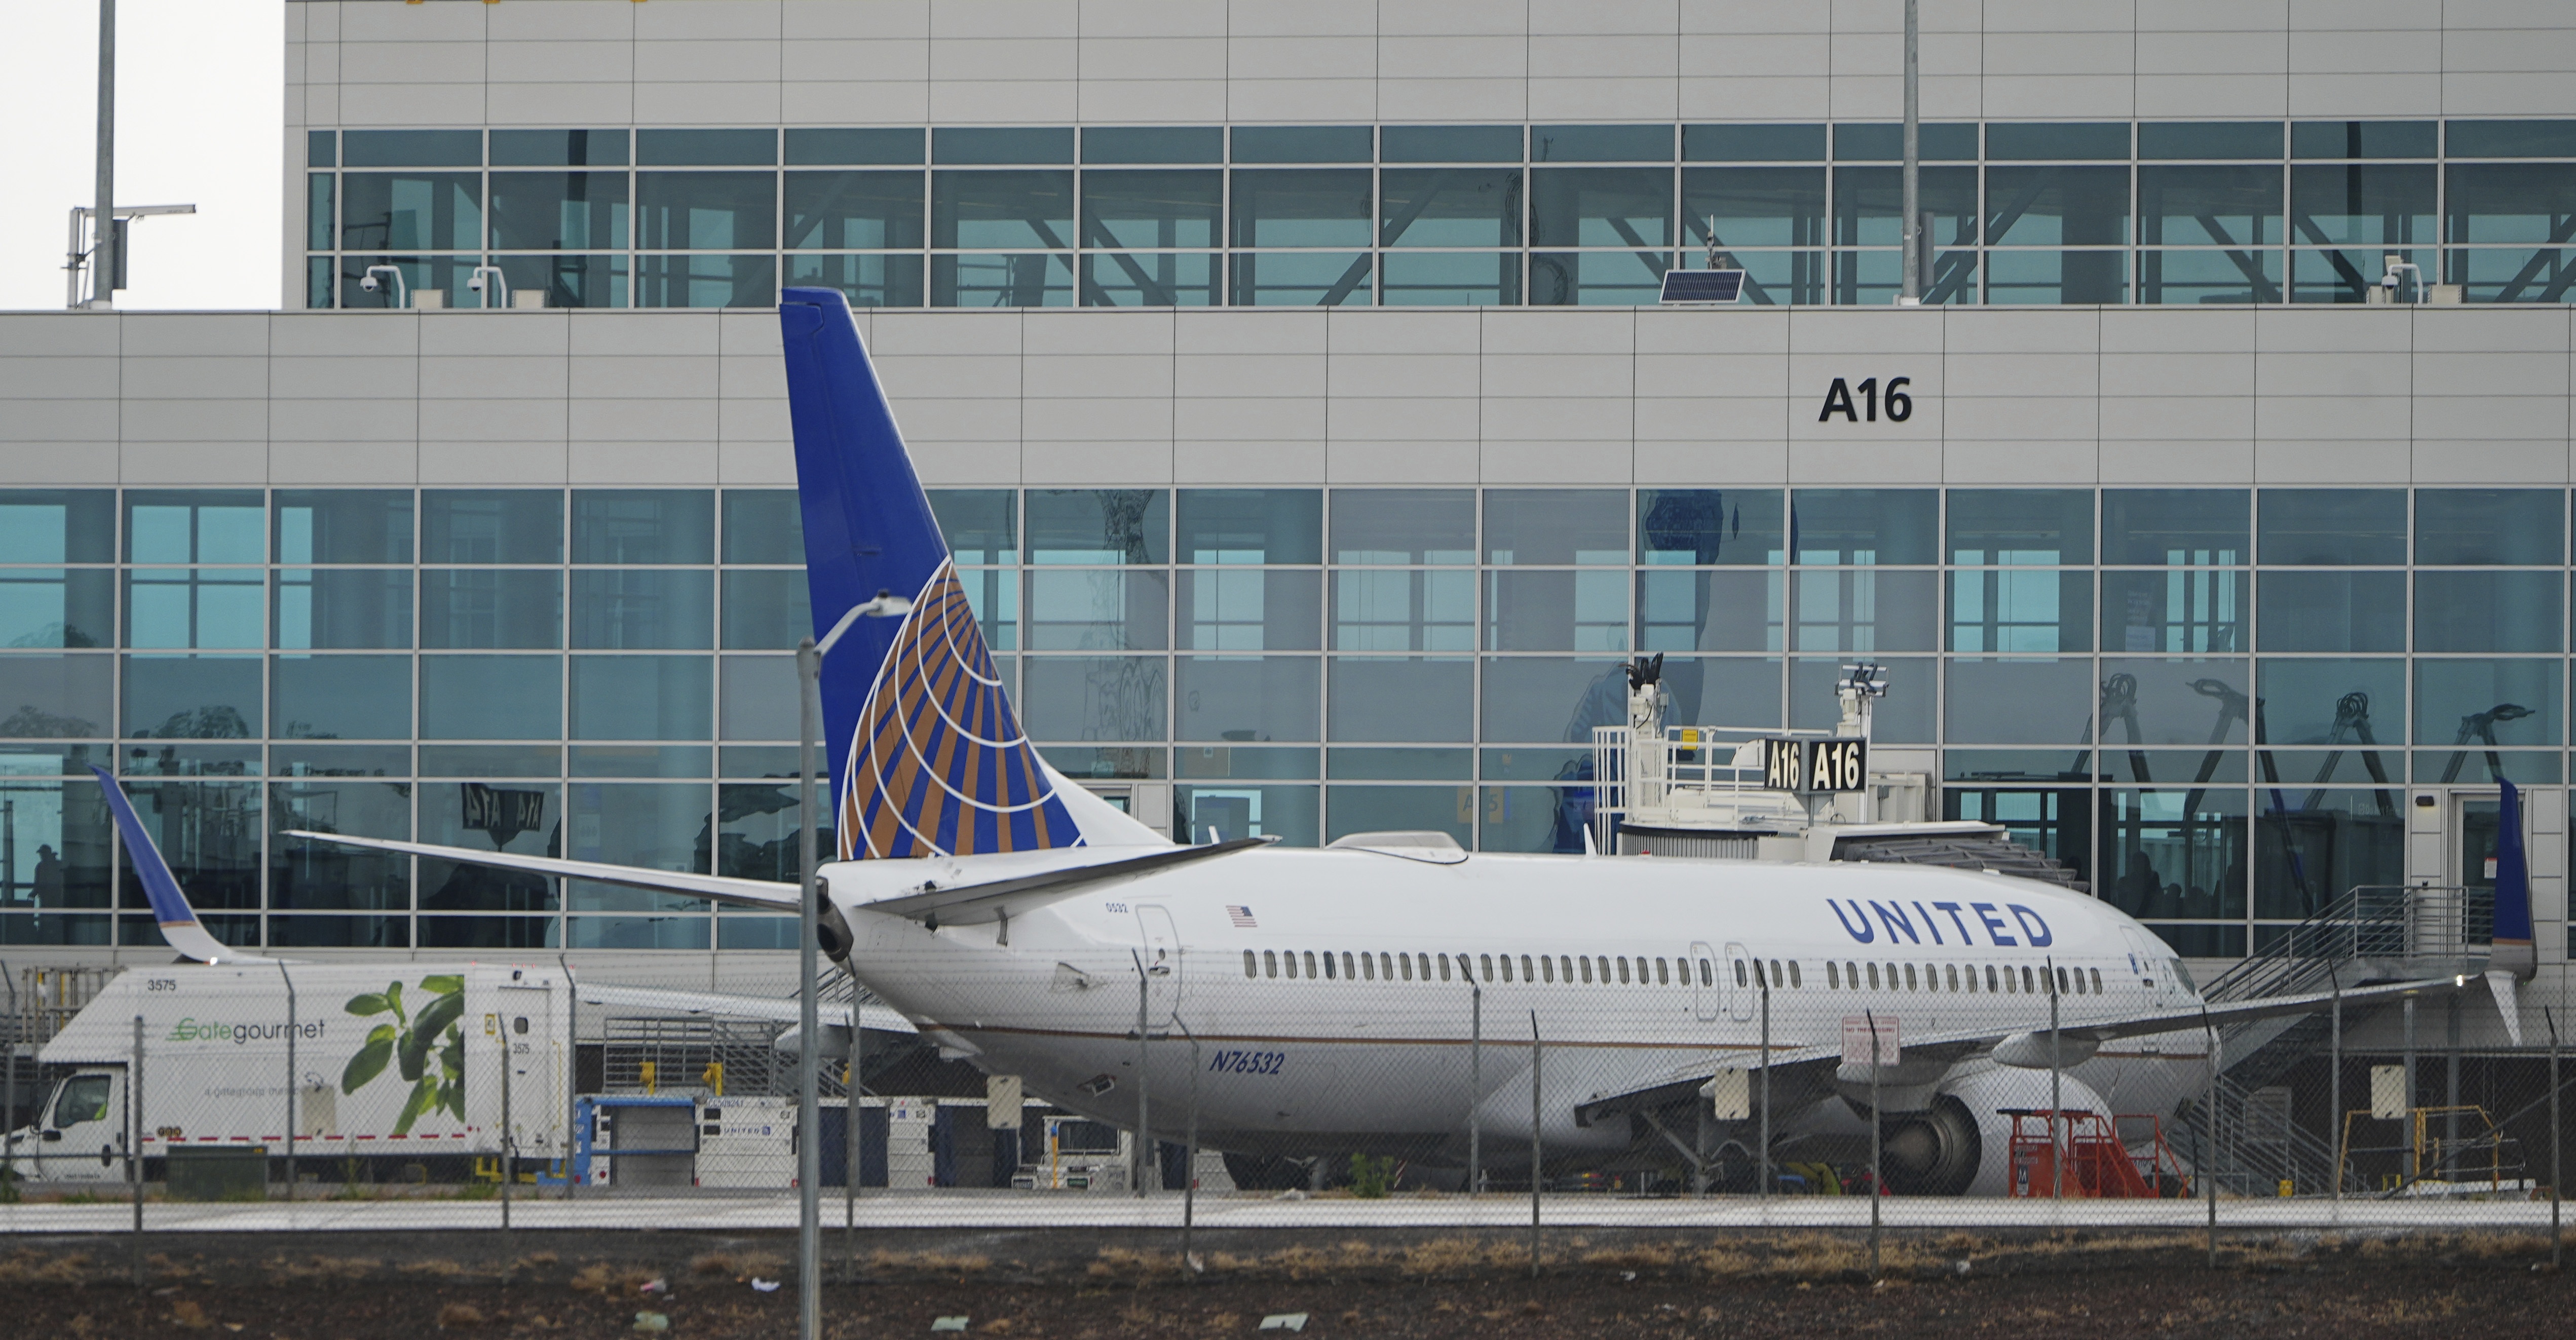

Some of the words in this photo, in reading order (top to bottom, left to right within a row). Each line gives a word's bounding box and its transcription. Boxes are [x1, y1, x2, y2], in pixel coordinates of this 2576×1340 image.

[1819, 376, 1912, 422] A16
[1768, 740, 1799, 790] A16
[1812, 742, 1860, 790] A16
[1826, 899, 2053, 947] UNITED
[147, 979, 176, 991] 3575
[1209, 1050, 1285, 1075] N76532
